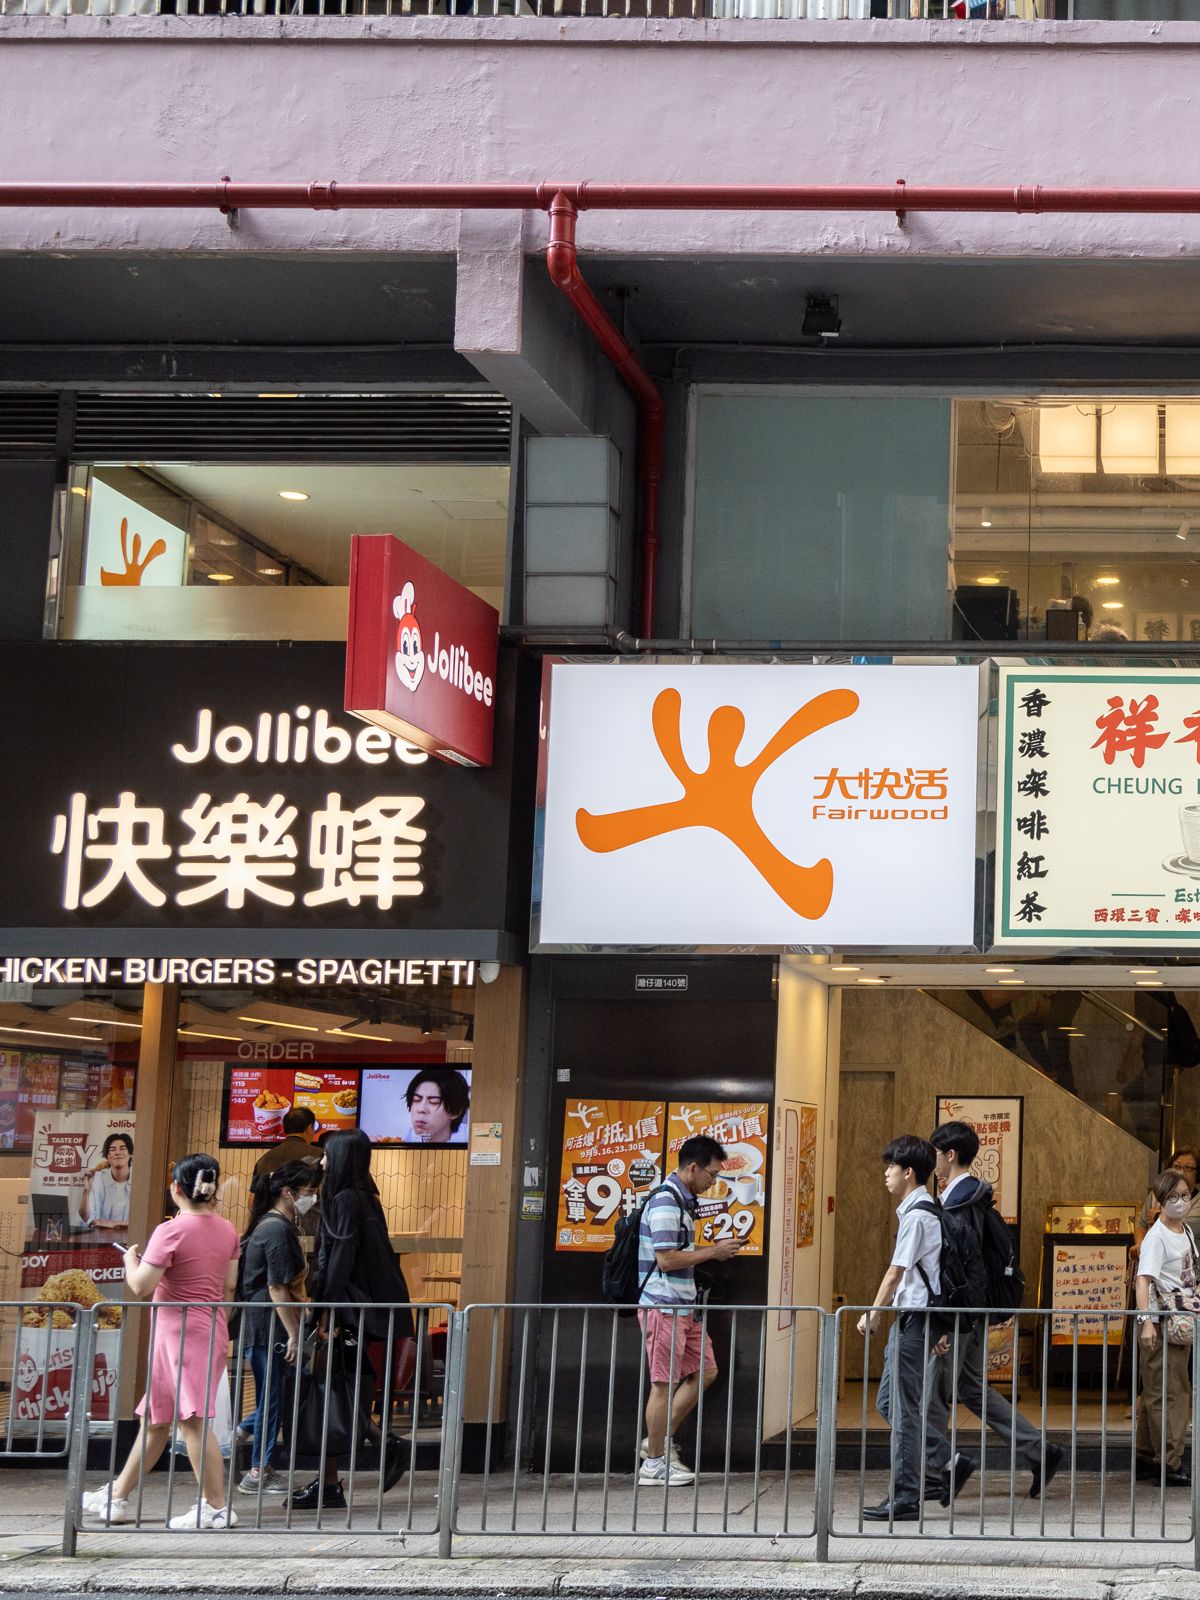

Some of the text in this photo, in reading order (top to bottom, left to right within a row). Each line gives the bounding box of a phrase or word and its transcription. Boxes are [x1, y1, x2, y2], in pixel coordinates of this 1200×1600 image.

[427, 631, 494, 707] Jollibee
[812, 767, 949, 801] 大快活
[1092, 777, 1183, 795] CHEUNG
[812, 805, 949, 820] Fairwood
[50, 791, 428, 911] 快樂蜂
[237, 1042, 315, 1060] ORDER
[107, 1120, 136, 1128] Jollib
[979, 1136, 1003, 1146] der
[703, 1210, 755, 1239] $29
[22, 1255, 50, 1268] JOY
